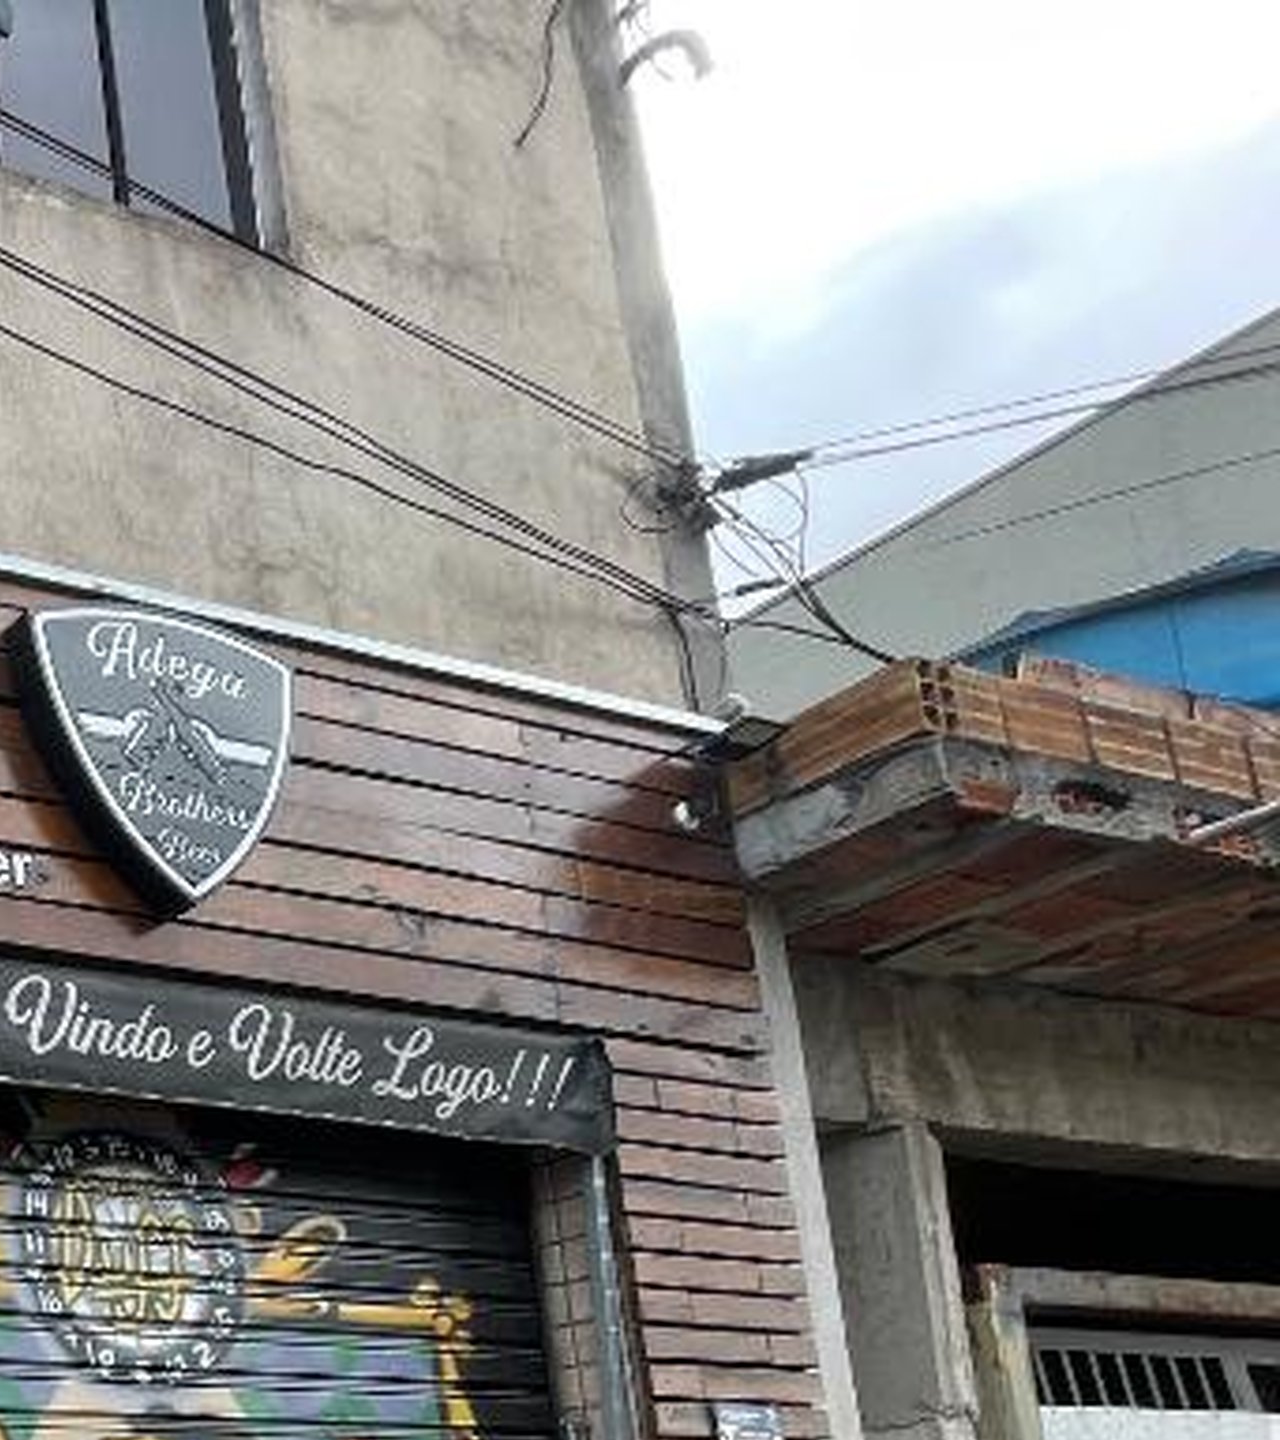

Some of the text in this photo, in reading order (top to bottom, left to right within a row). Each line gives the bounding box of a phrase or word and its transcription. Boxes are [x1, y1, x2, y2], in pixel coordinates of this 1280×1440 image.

[86, 621, 246, 699] Adega
[3, 972, 179, 1058] Vindo
[186, 1030, 217, 1063] e
[227, 1002, 365, 1087] Volte
[372, 1026, 576, 1120] Logo!!!
